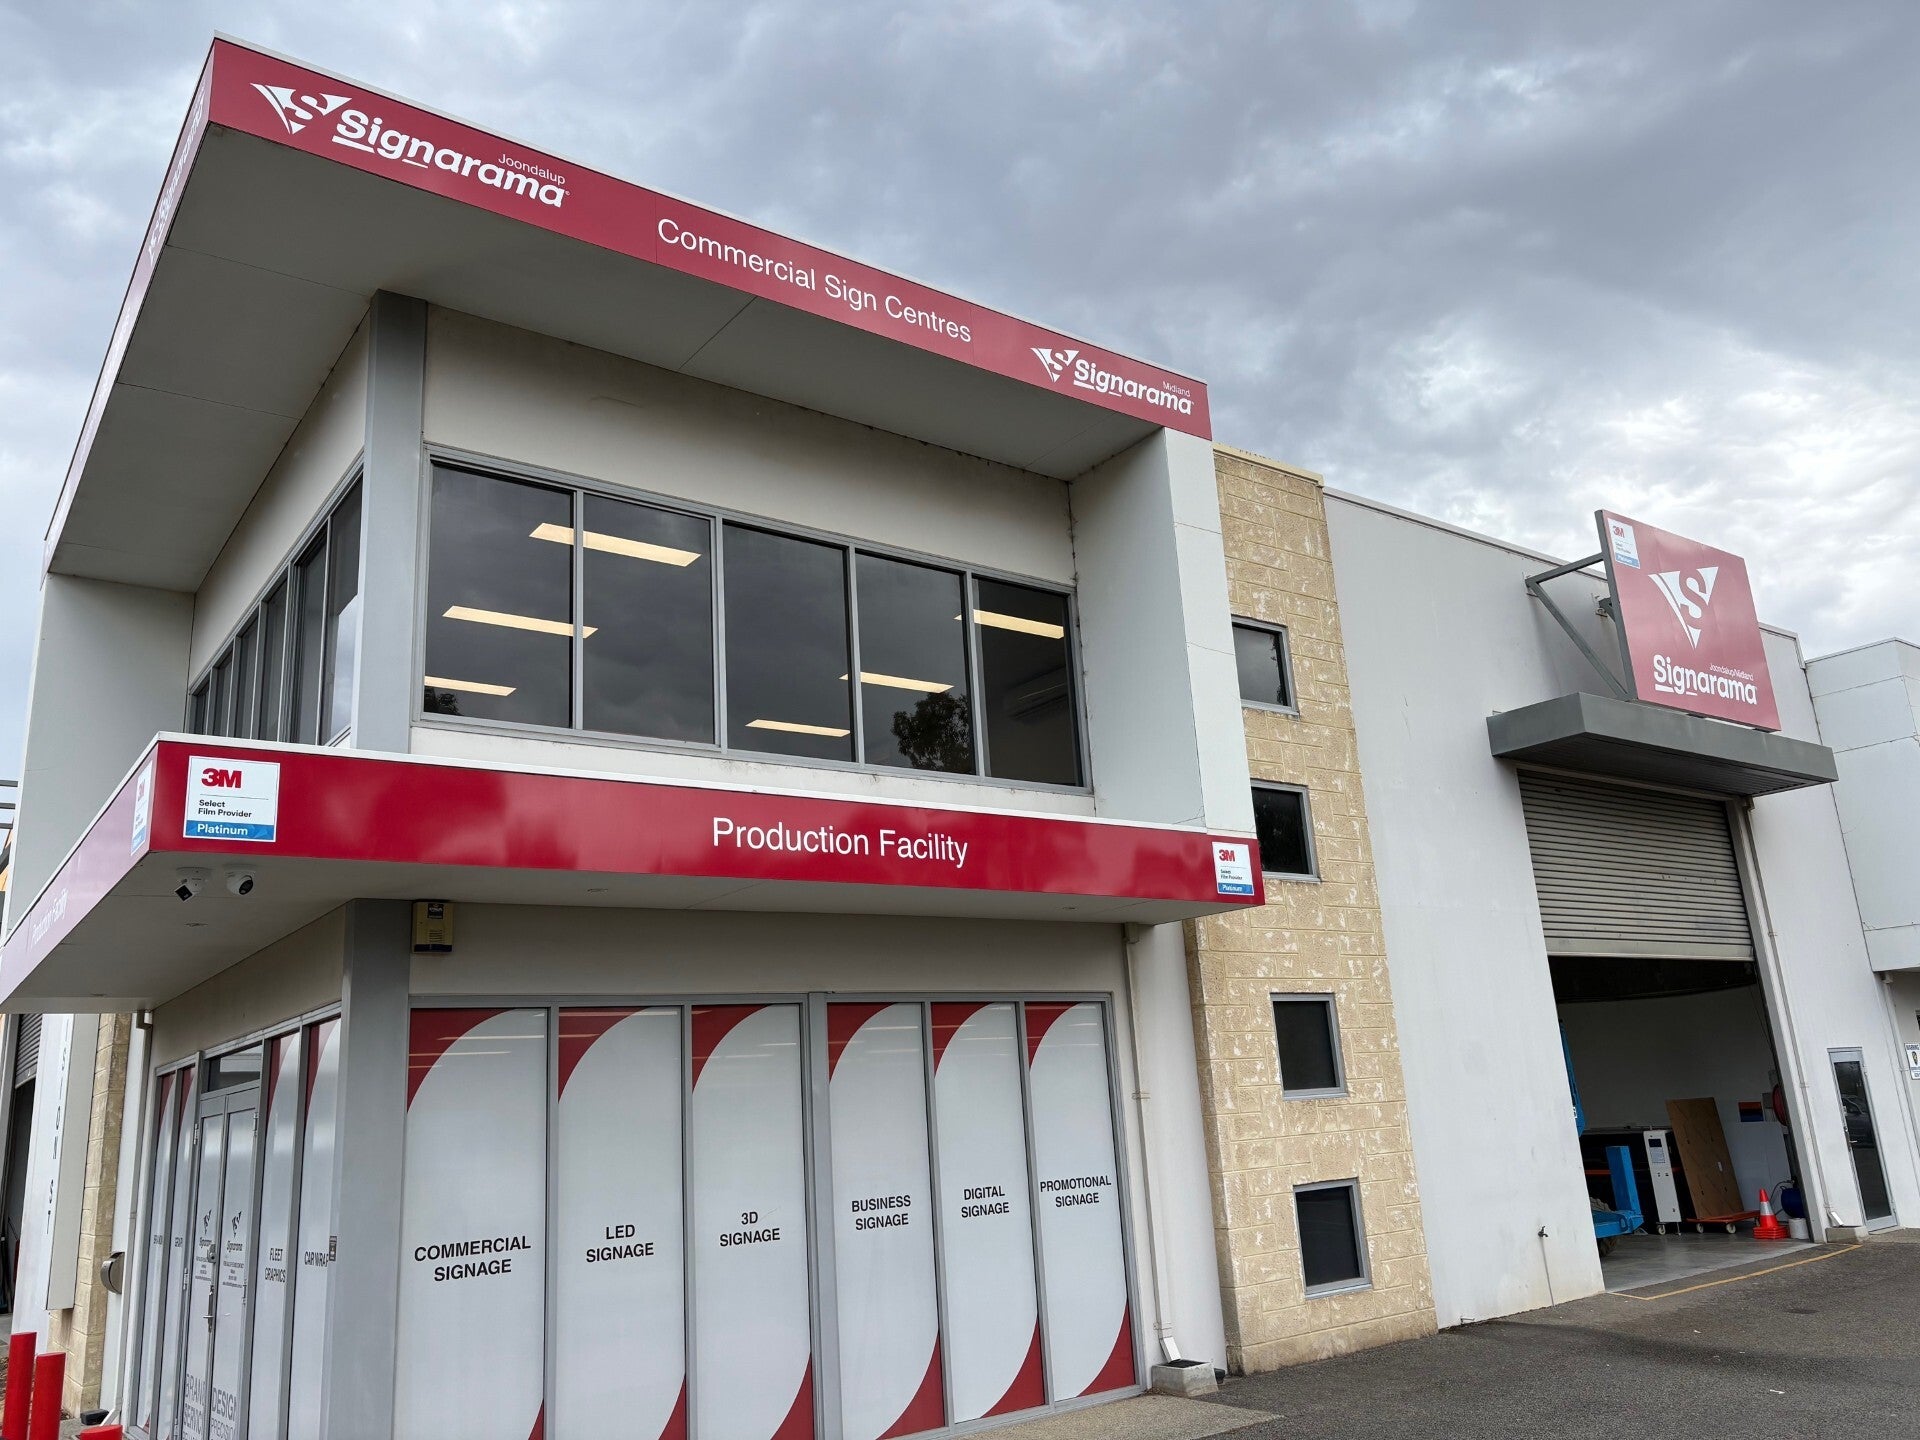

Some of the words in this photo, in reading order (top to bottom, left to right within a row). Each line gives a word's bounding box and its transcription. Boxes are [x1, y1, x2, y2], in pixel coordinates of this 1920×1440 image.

[336, 109, 565, 208] Signarama
[498, 153, 566, 186] Joondalup
[658, 218, 816, 291] Commercial
[824, 274, 877, 312] Sign
[884, 295, 972, 343] Centres
[1075, 358, 1192, 416] Signarama
[1162, 381, 1191, 397] Midland
[1653, 654, 1758, 705] Signarama
[201, 767, 242, 789] 3M
[197, 807, 216, 816] Film
[217, 808, 252, 818] Provider
[198, 799, 226, 808] Select
[196, 823, 249, 836] Platinum
[713, 816, 869, 855] Production
[879, 829, 968, 869] Facility
[1218, 849, 1236, 862] 3M
[963, 1185, 1006, 1201] DIGITAL
[1040, 1175, 1112, 1193] PROMOTIONAL
[851, 1194, 911, 1213] BUSINESS
[1055, 1192, 1100, 1208] SIGNAGE
[741, 1211, 759, 1225] 3D
[961, 1202, 1010, 1218] SIGNAGE
[855, 1213, 909, 1231] SIGNAGE
[606, 1224, 636, 1240] LED
[719, 1227, 781, 1247] SIGNAGE
[269, 1247, 283, 1262] FLEET
[414, 1235, 532, 1262] COMMERCIAL
[586, 1242, 654, 1263] SIGNAGE
[304, 1250, 315, 1266] CAR
[264, 1266, 286, 1283] GRAPHICS
[434, 1258, 512, 1282] SIGNAGE
